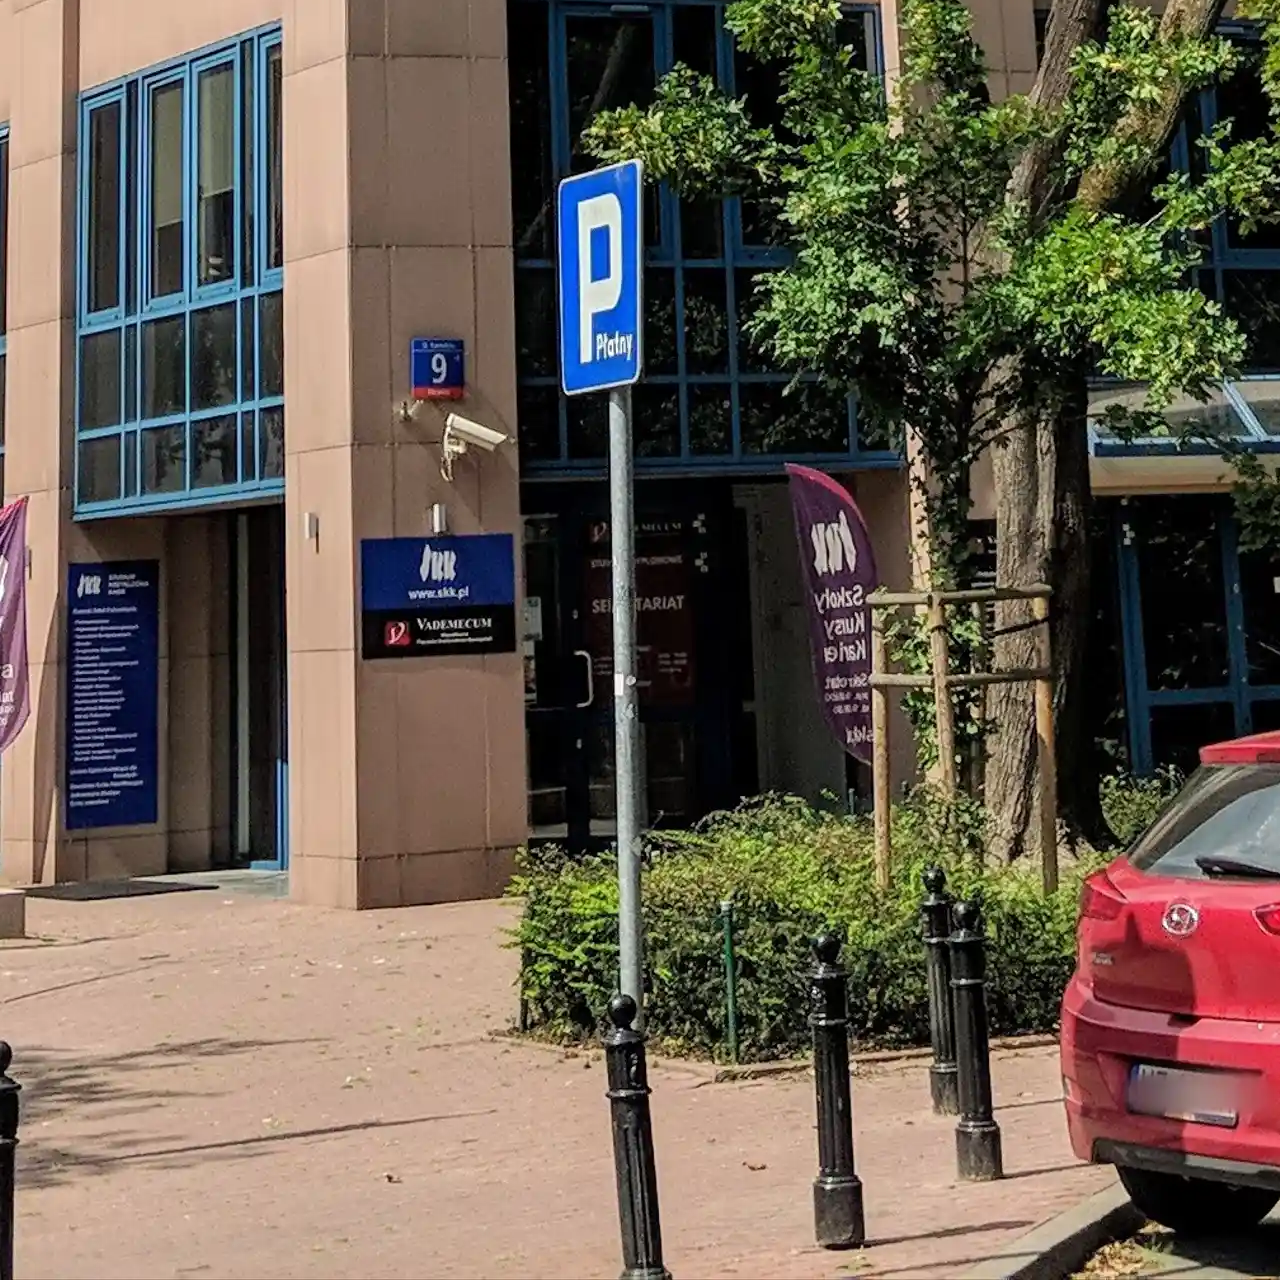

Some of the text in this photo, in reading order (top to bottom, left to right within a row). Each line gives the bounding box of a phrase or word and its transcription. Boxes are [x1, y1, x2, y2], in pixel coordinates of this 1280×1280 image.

[577, 192, 622, 364] P
[595, 331, 634, 361] Płatny
[431, 353, 447, 384] 9
